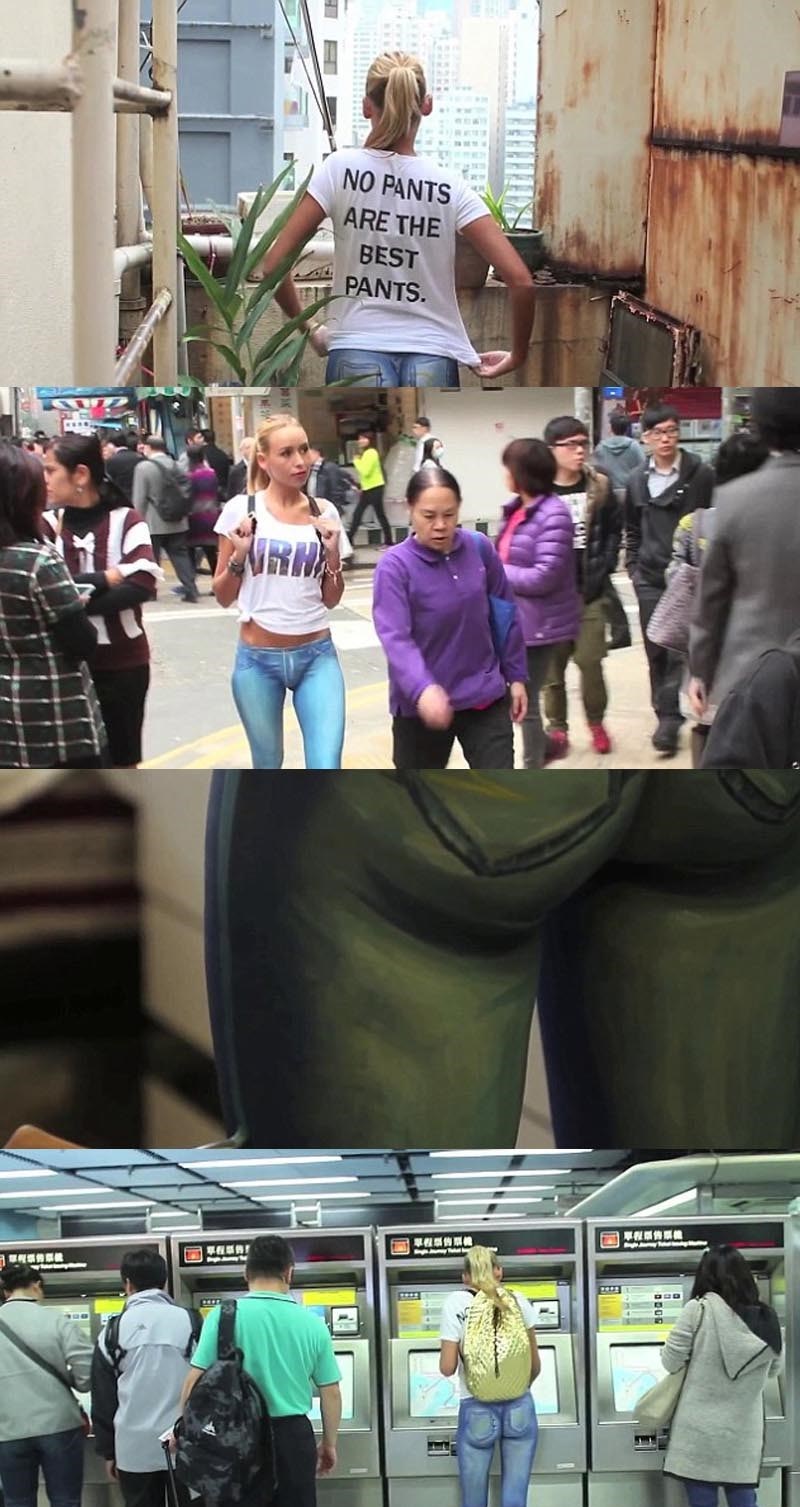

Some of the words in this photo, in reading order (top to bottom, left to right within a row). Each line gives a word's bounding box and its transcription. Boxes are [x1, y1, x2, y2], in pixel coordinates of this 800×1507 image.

[343, 168, 375, 193] NO
[382, 174, 452, 205] PANTS
[343, 207, 390, 232] ARE
[395, 214, 441, 238] THE
[360, 244, 419, 269] BEST
[345, 276, 426, 303] PANTS.
